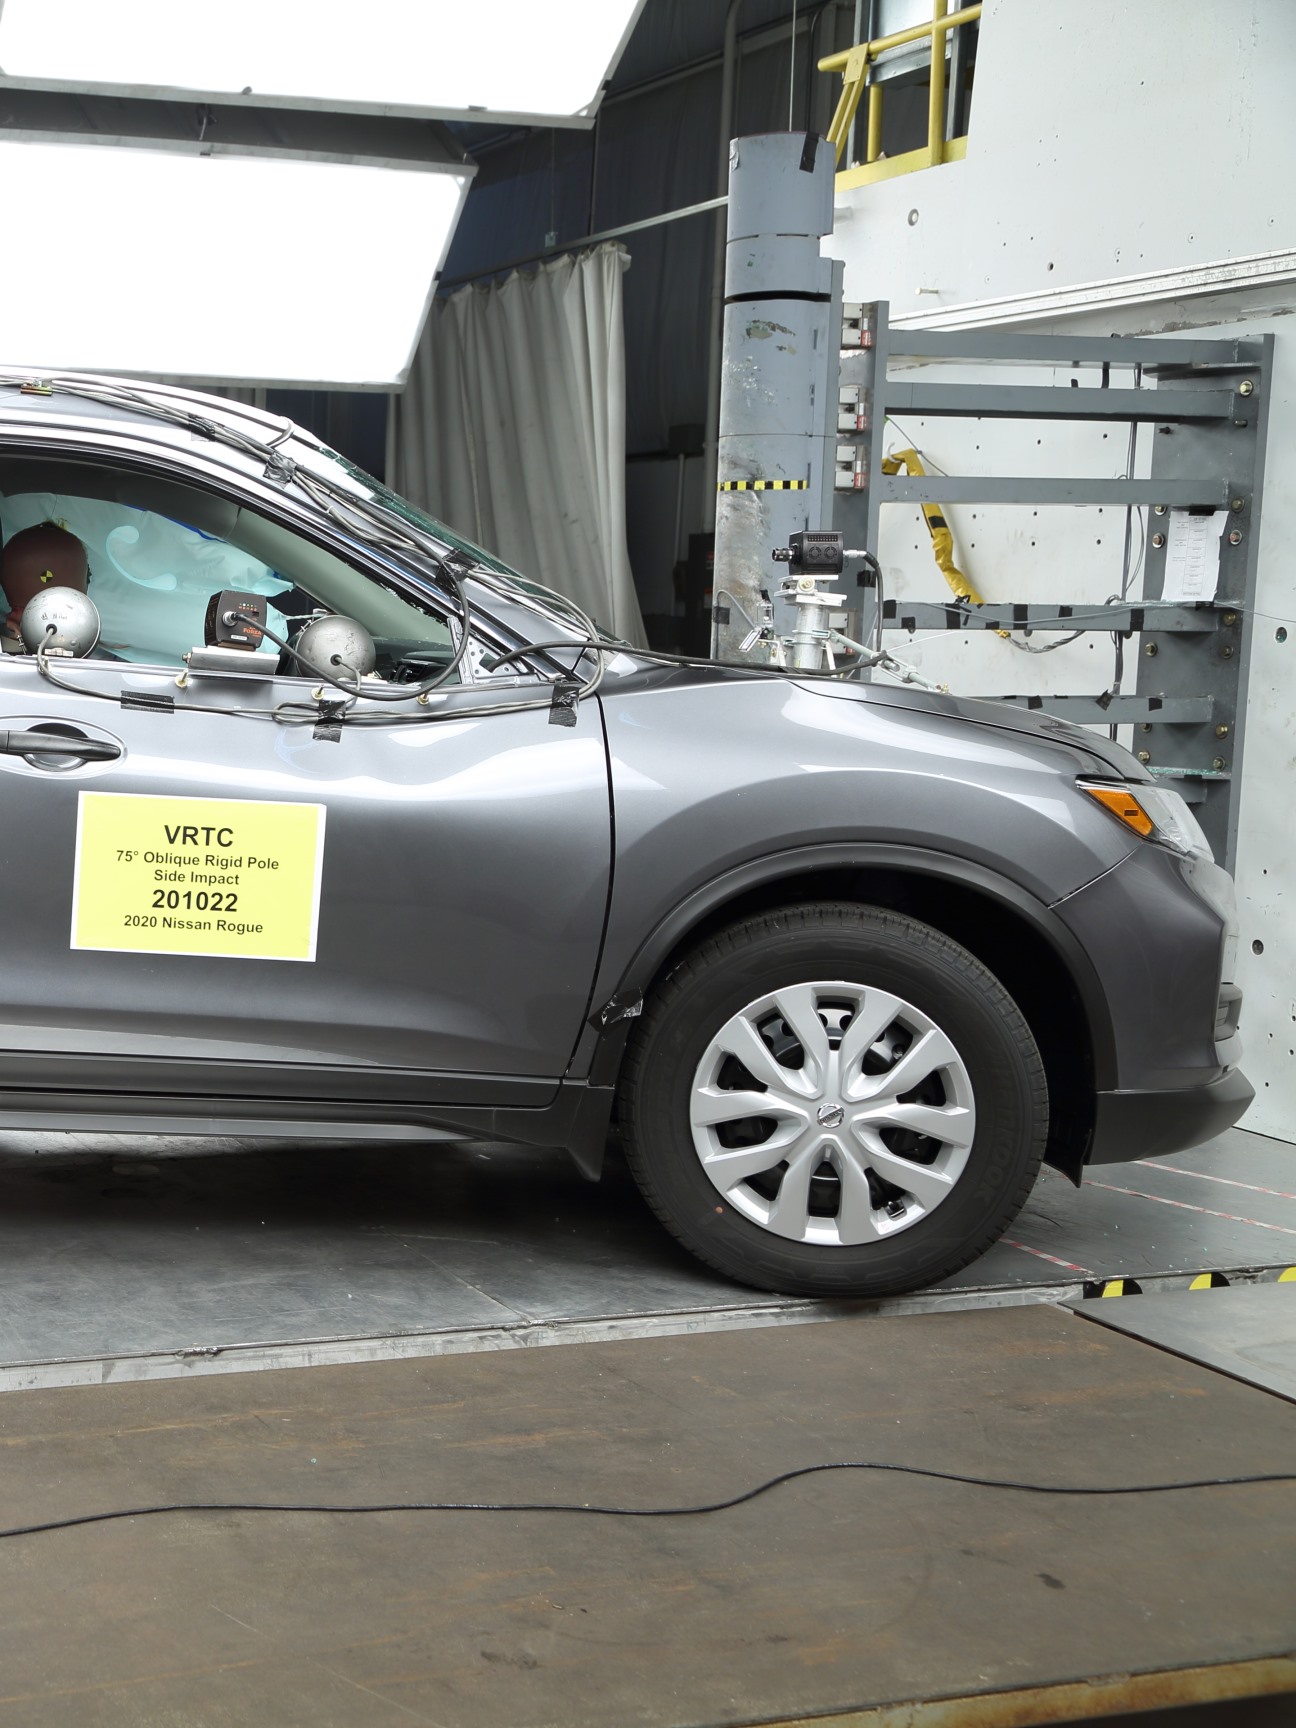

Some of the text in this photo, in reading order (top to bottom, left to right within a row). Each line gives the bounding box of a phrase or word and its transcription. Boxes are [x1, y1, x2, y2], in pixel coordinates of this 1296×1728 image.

[164, 825, 234, 848] VRTC
[143, 851, 200, 868] Oblique
[204, 854, 243, 870] Rigid
[247, 856, 280, 870] Pole
[154, 869, 240, 887] Side Impact
[151, 889, 238, 912] 201022
[124, 915, 264, 935] 2020 Nissan Rogue
